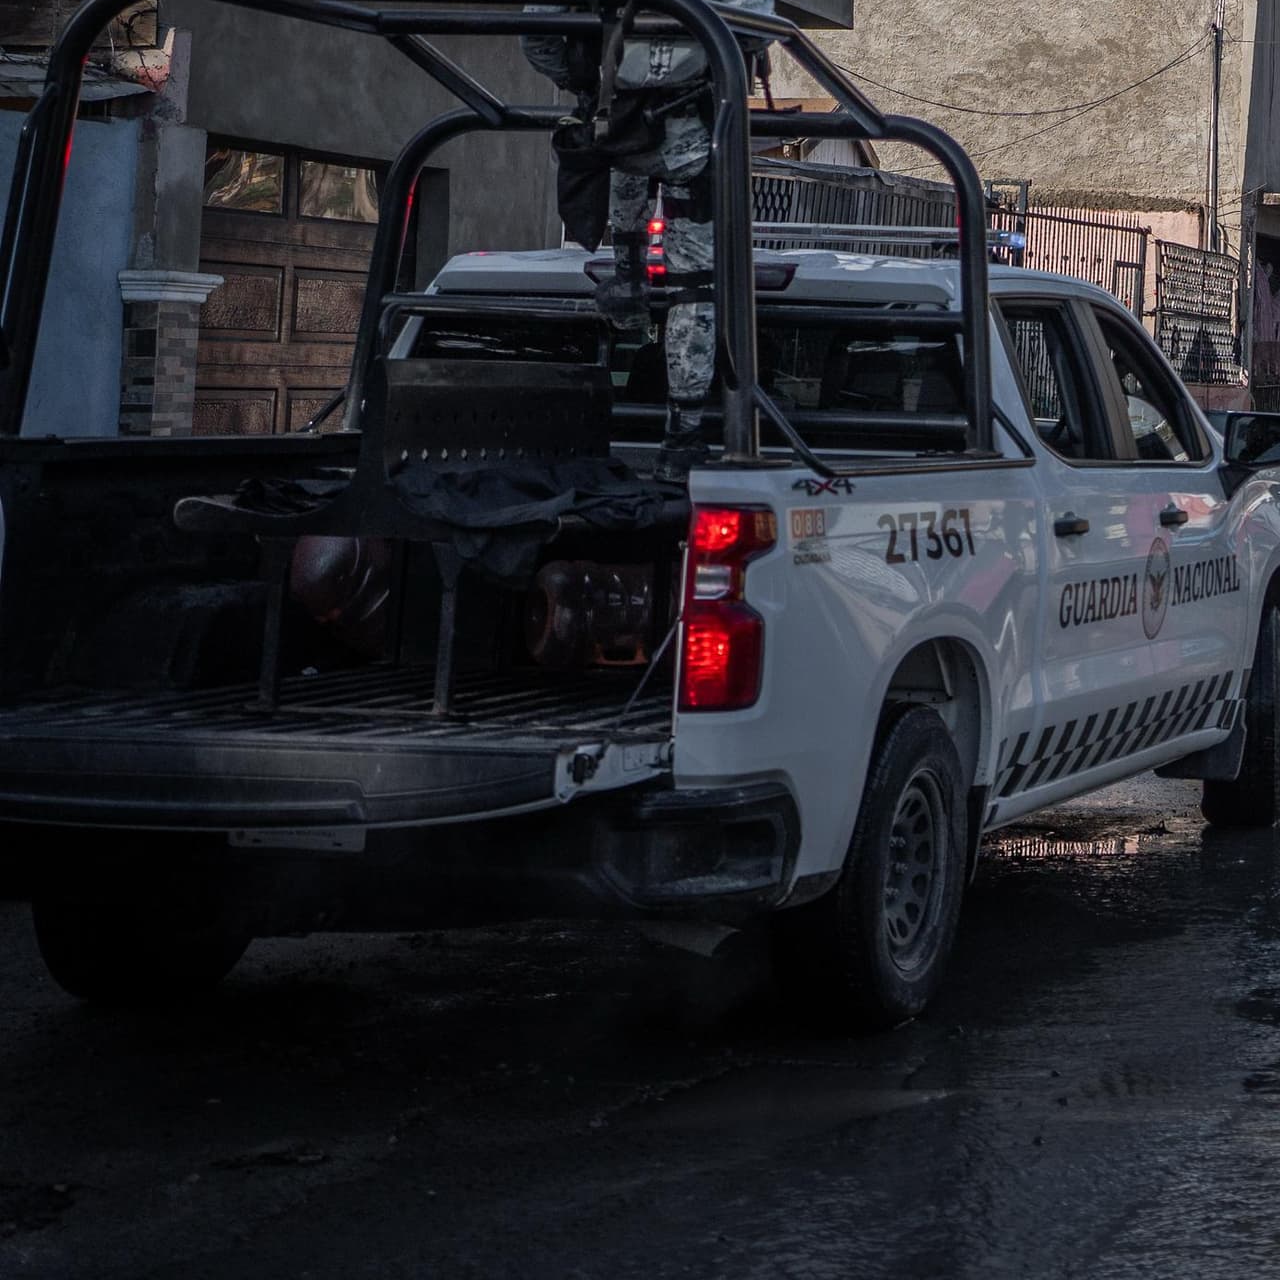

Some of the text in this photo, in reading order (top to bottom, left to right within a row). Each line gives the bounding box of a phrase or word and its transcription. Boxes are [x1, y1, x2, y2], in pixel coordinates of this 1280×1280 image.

[791, 510, 825, 538] 088
[877, 508, 976, 565] 27361
[1059, 554, 1241, 629] GUARDIA NACIONAL
